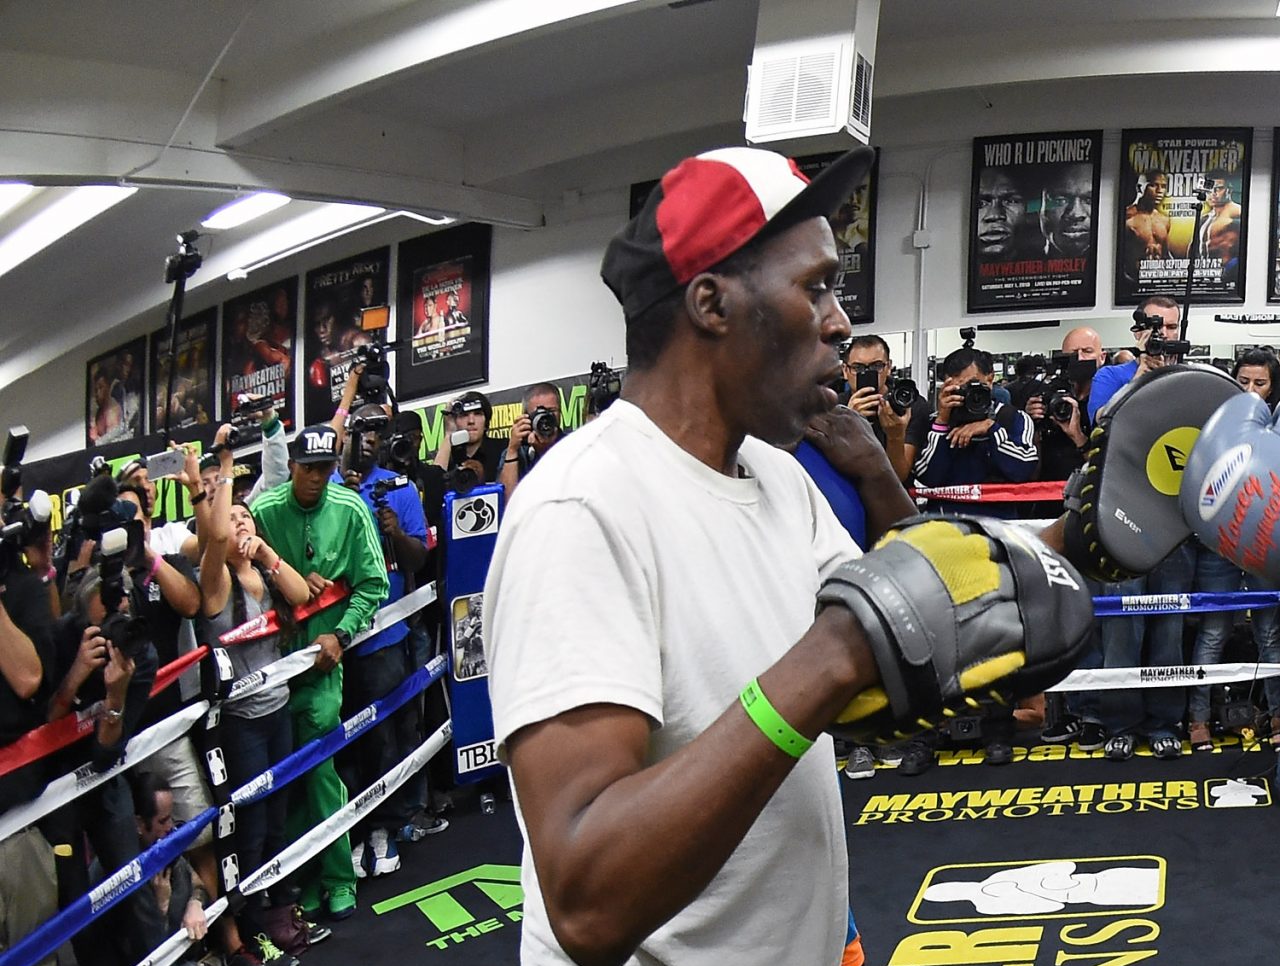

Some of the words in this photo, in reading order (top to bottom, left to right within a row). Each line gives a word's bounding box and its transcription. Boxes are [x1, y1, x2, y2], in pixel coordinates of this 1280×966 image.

[984, 144, 1010, 167] WHO
[1014, 143, 1024, 164] R
[1026, 142, 1034, 164] U
[1037, 138, 1092, 163] PICKING?
[1158, 139, 1182, 147] STAR
[1185, 139, 1218, 147] POWER
[1133, 149, 1240, 174] MAYWEATHER
[231, 364, 285, 392] MAYWEATHER
[304, 432, 336, 450] TMT
[1114, 507, 1142, 533] Ever
[1122, 594, 1180, 606] MAYWEATHER
[1122, 603, 1181, 611] PROMOTIONS
[1140, 666, 1196, 678] MAYWEATHER
[1140, 675, 1197, 683] PROMOTIONS
[866, 780, 1199, 813] MAYWEATHER
[853, 797, 1201, 825] PROMOTIONS
[426, 917, 504, 951] THE
